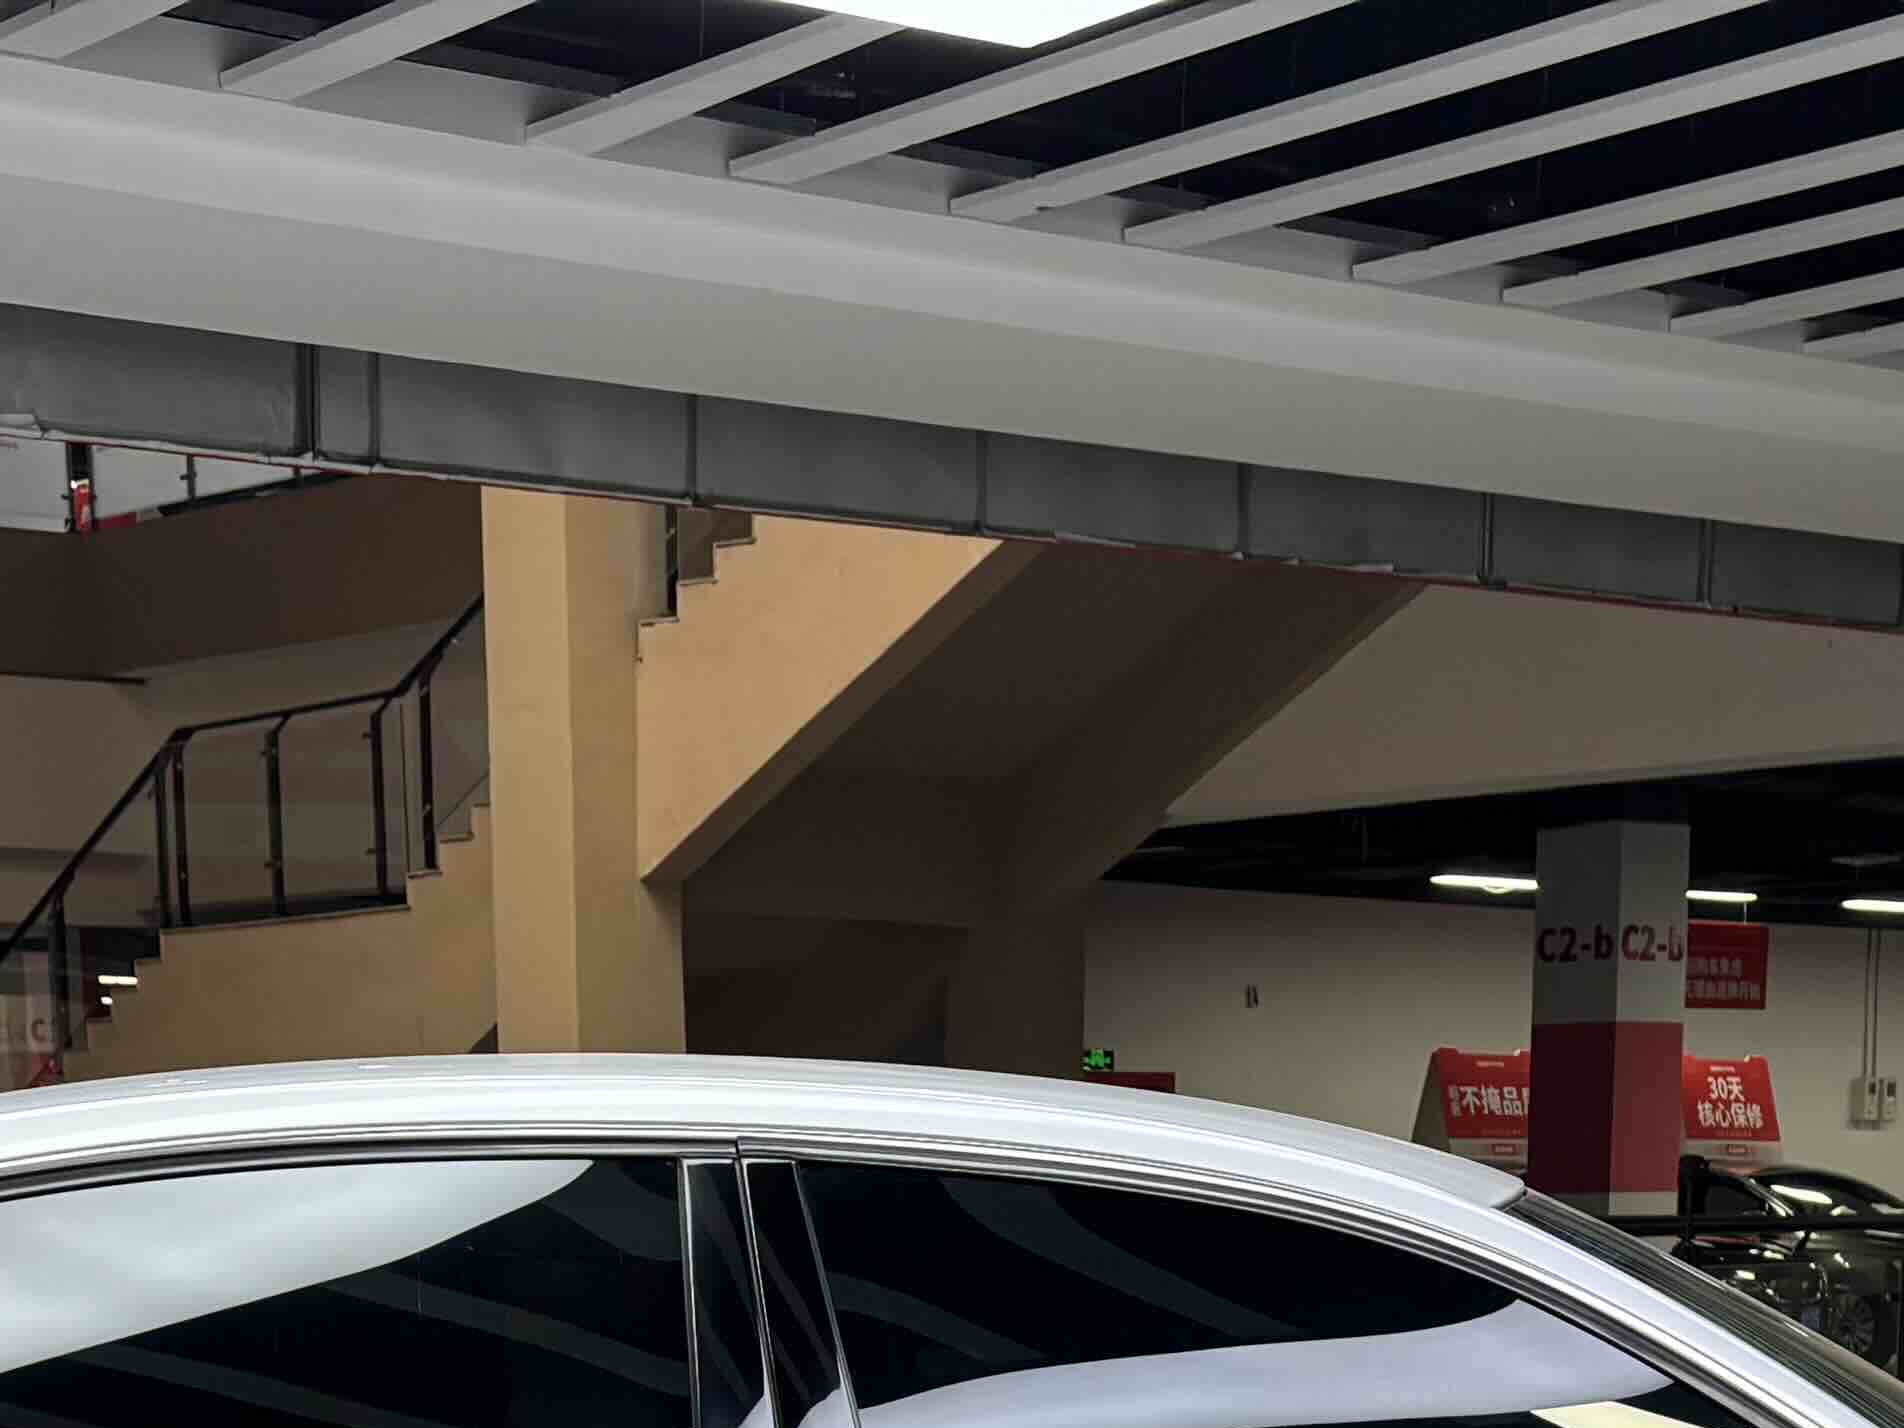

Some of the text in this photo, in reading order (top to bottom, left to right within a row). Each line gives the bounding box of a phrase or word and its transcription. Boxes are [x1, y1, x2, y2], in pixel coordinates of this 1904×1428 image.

[1537, 925, 1614, 963] C2-b
[1621, 924, 1684, 962] C2-b
[1707, 1076, 1745, 1101] 30天
